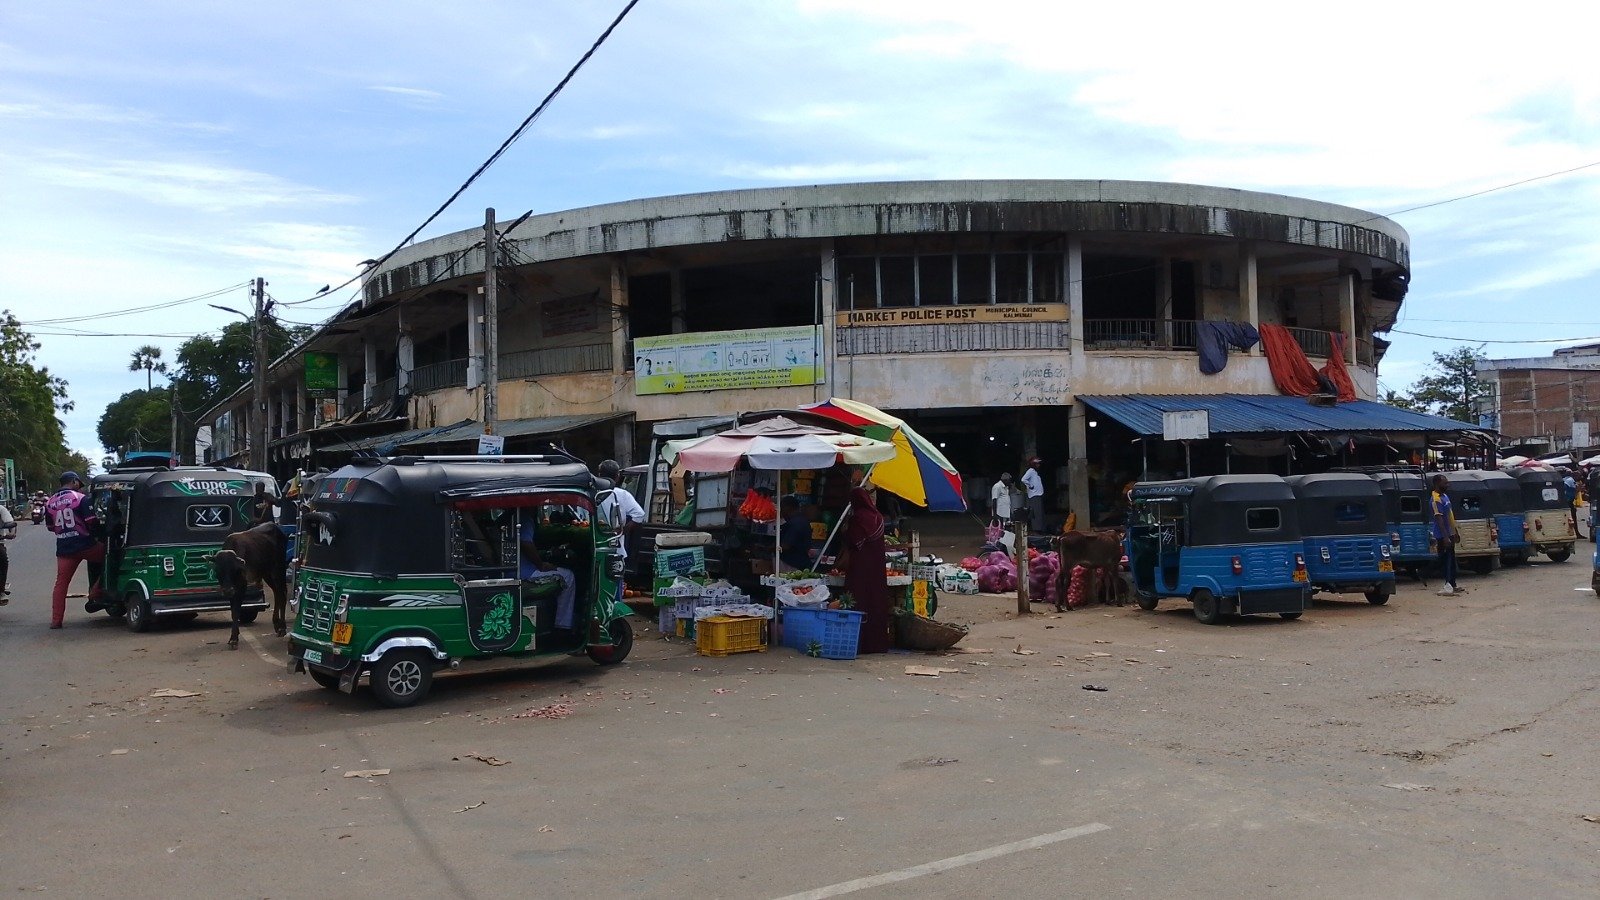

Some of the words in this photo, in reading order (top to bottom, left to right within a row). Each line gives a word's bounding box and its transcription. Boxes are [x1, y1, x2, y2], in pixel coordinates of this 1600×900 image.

[900, 309, 943, 320] POLICE
[945, 308, 977, 319] POST
[187, 481, 228, 490] KIDDO
[55, 508, 76, 529] 49
